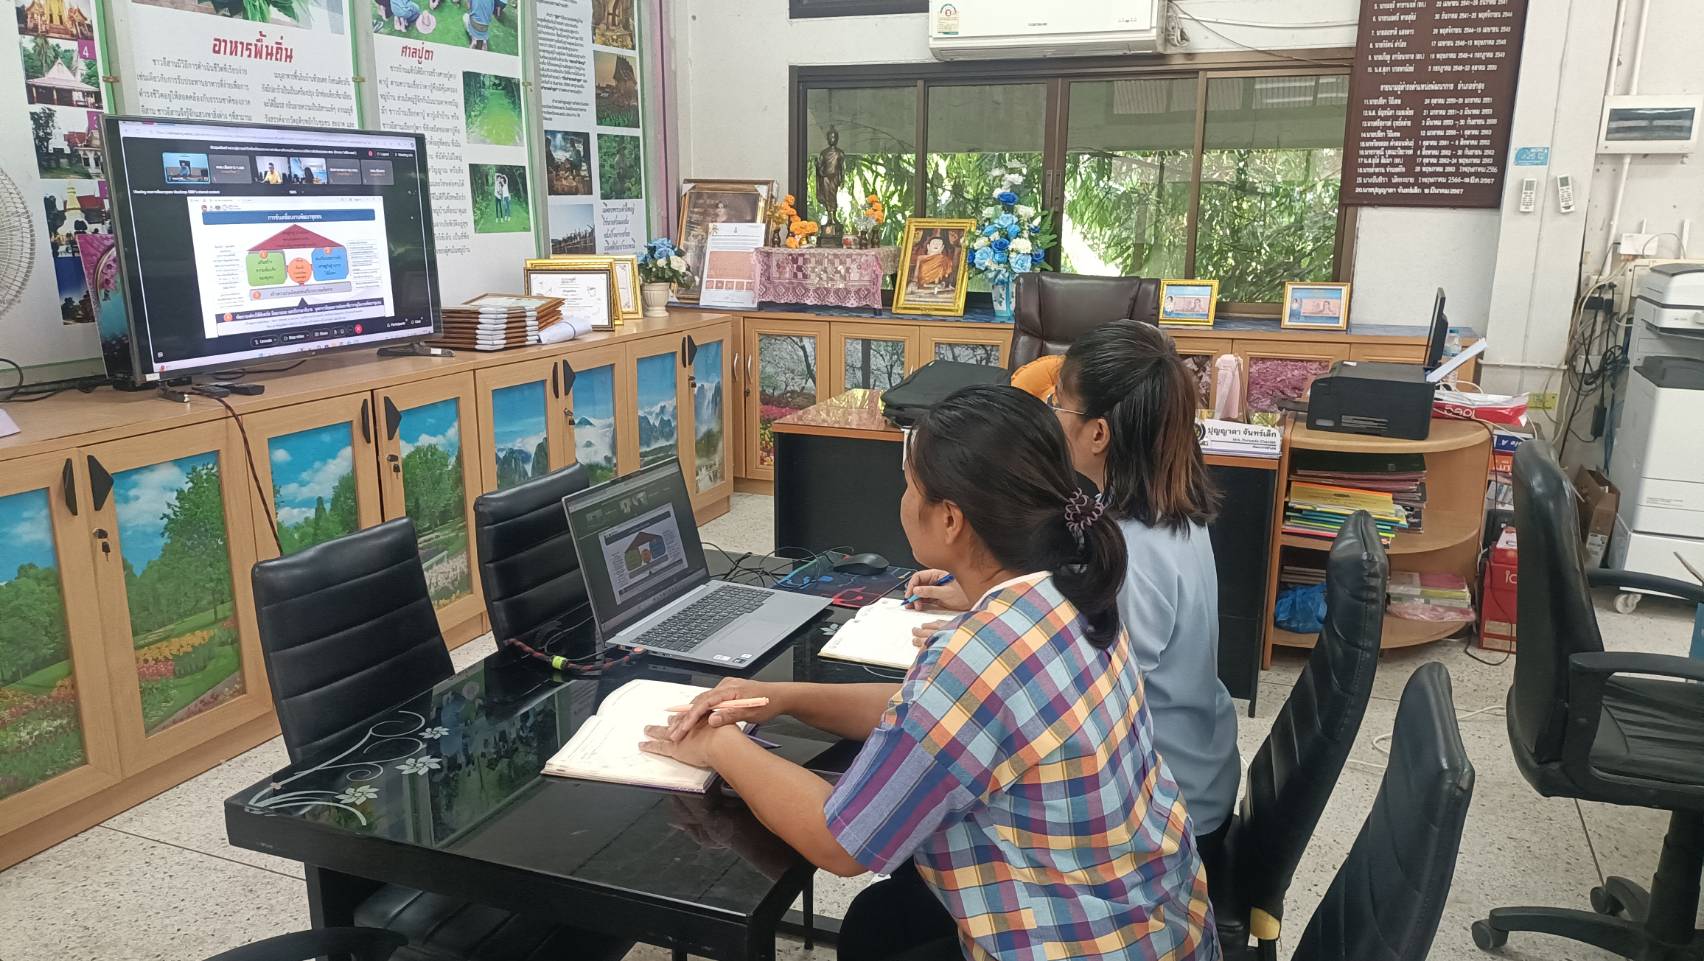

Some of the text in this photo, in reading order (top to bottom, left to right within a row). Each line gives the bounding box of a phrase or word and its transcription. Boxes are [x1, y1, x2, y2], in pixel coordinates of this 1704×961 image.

[83, 46, 89, 58] 4
[212, 31, 293, 63] อาหารพื้นถิ่น
[401, 41, 433, 64] ศาลปู่ตา
